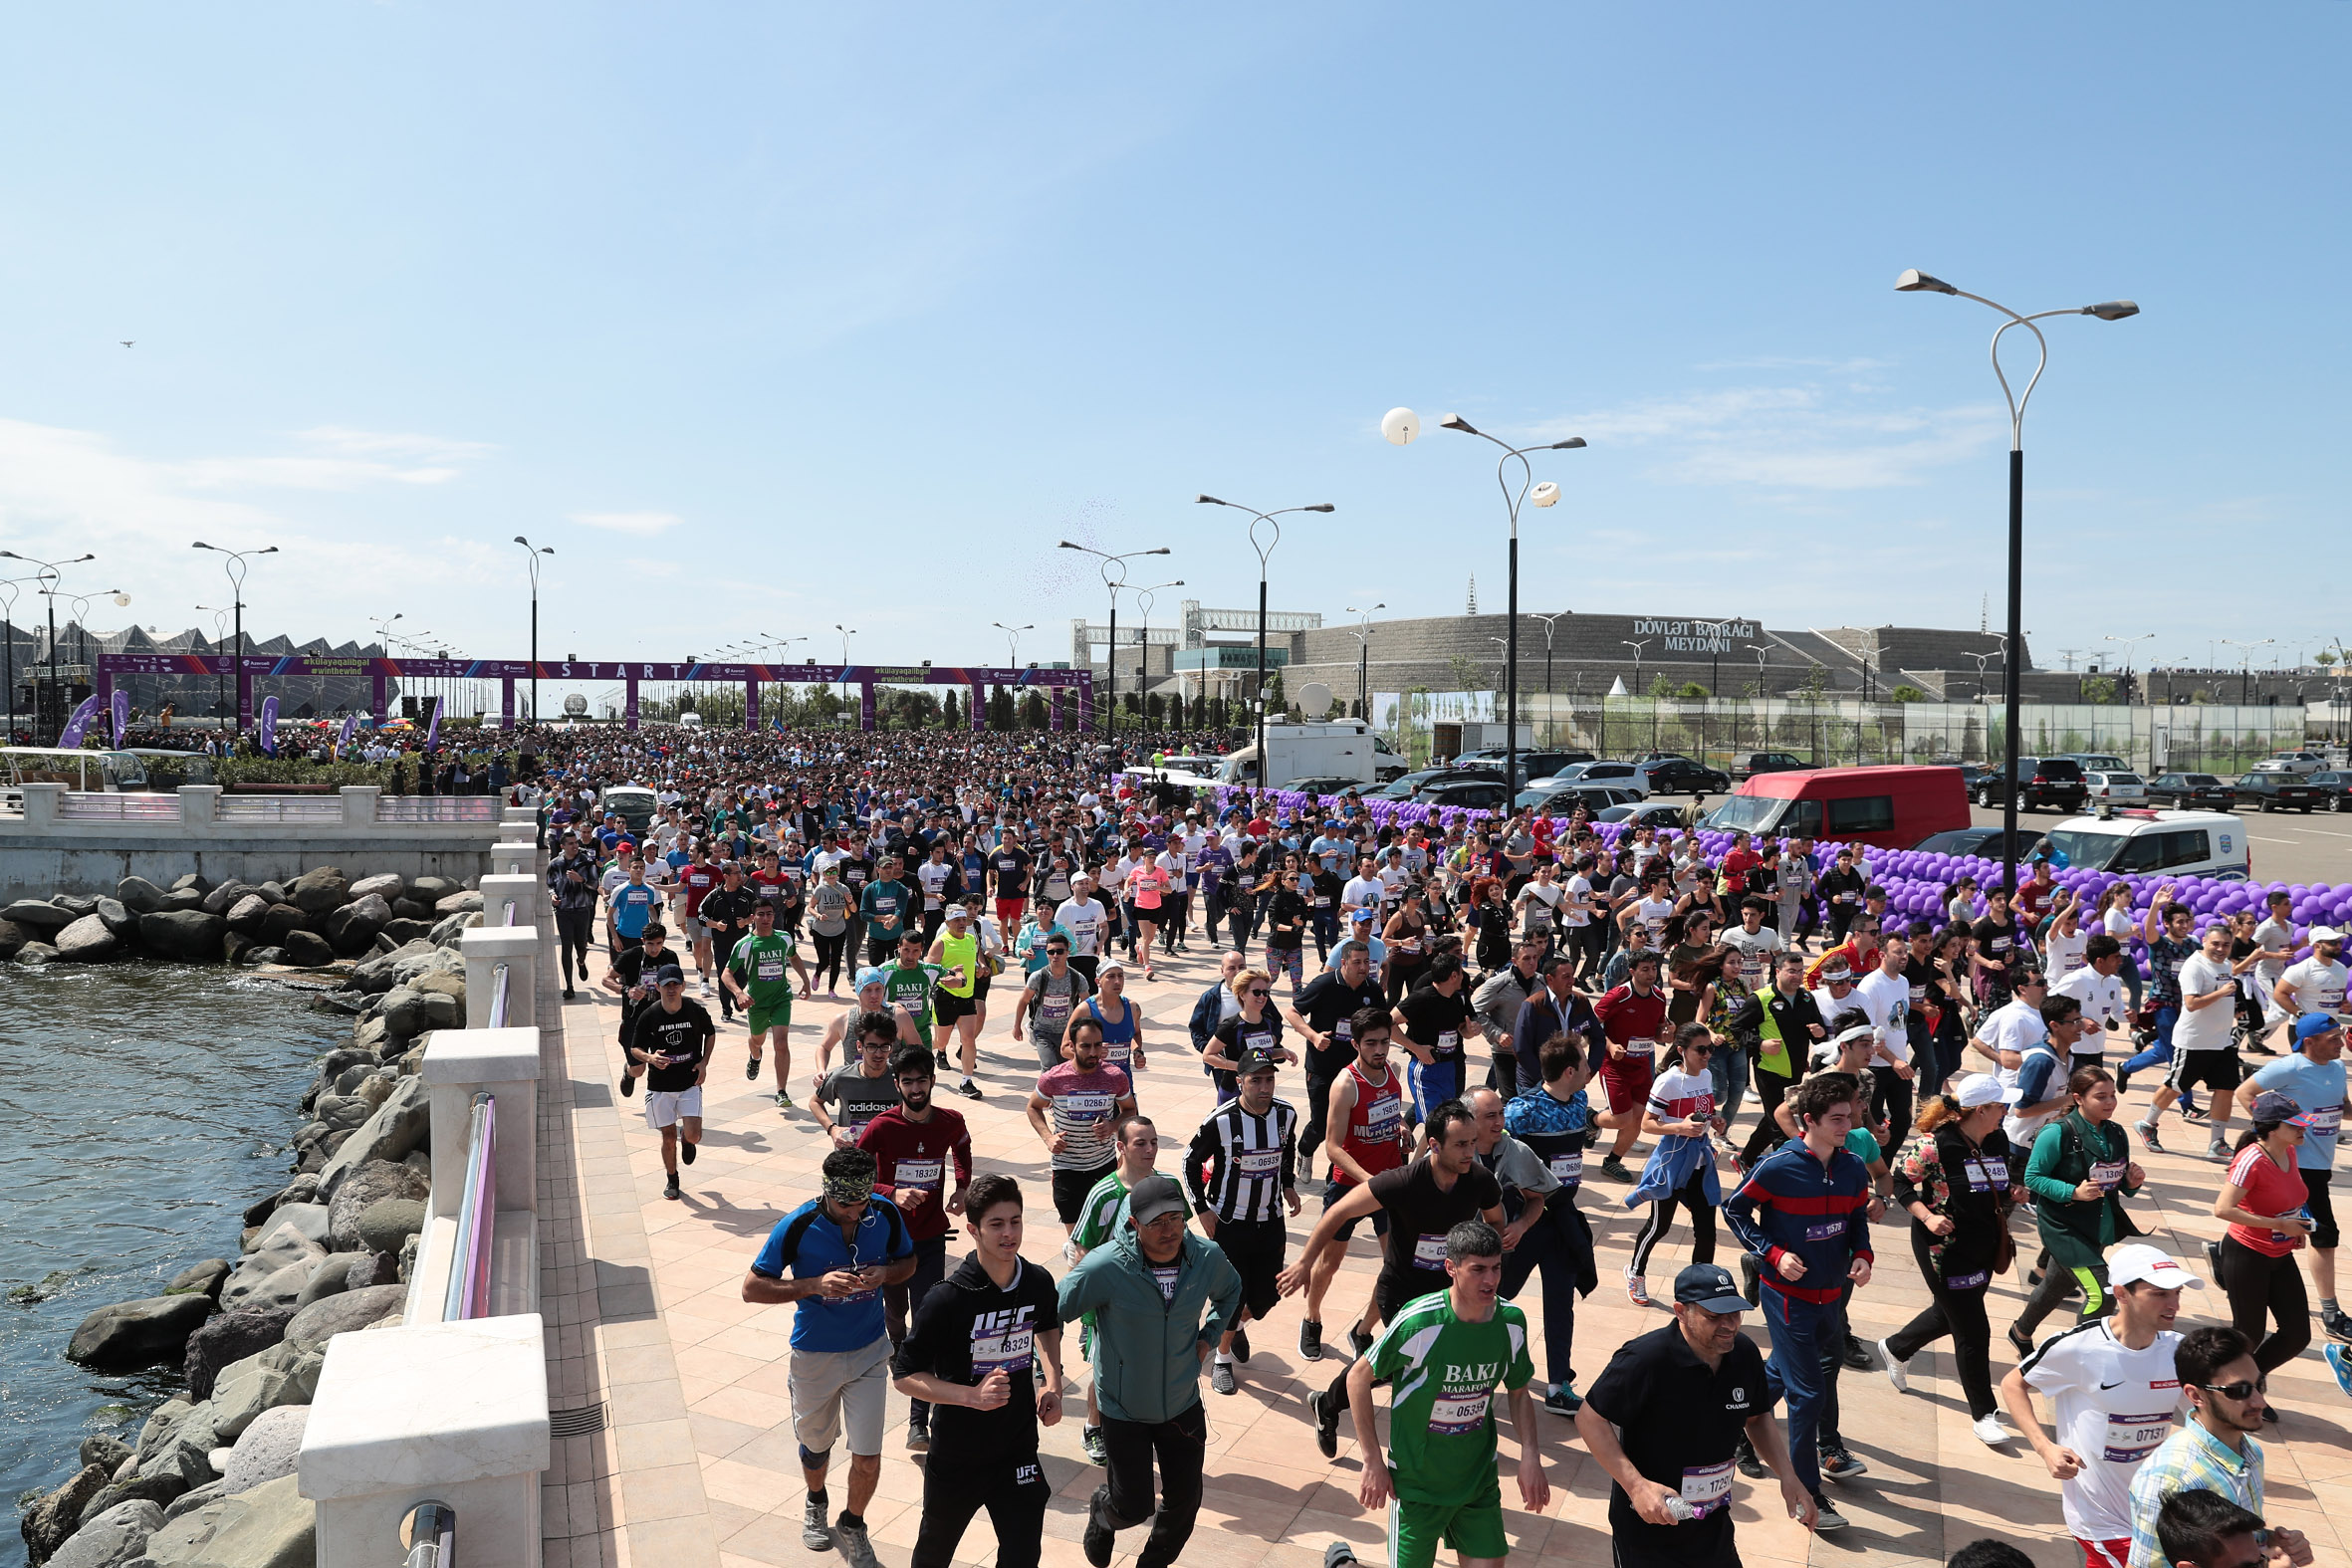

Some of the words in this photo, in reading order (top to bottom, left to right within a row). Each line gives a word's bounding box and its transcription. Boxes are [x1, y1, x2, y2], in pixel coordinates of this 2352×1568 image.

[1633, 617, 1690, 636] DÖVLƏT
[1695, 621, 1754, 638] BAYRAĞI
[1664, 637, 1731, 653] MEYDANI
[562, 663, 681, 679] START
[759, 950, 782, 960] BAKI
[896, 983, 922, 993] BAKI
[848, 1102, 886, 1112] adidas
[1258, 1155, 1280, 1166] 06939
[915, 1168, 938, 1179] 18328
[1986, 1167, 2006, 1177] 2489
[970, 1304, 1036, 1340] UFC
[1001, 1335, 1030, 1353] 18329
[1442, 1362, 1500, 1383] BAKI
[1441, 1380, 1494, 1394] MARAFONU
[2136, 1426, 2166, 1442] 07131
[1016, 1464, 1039, 1479] UFC
